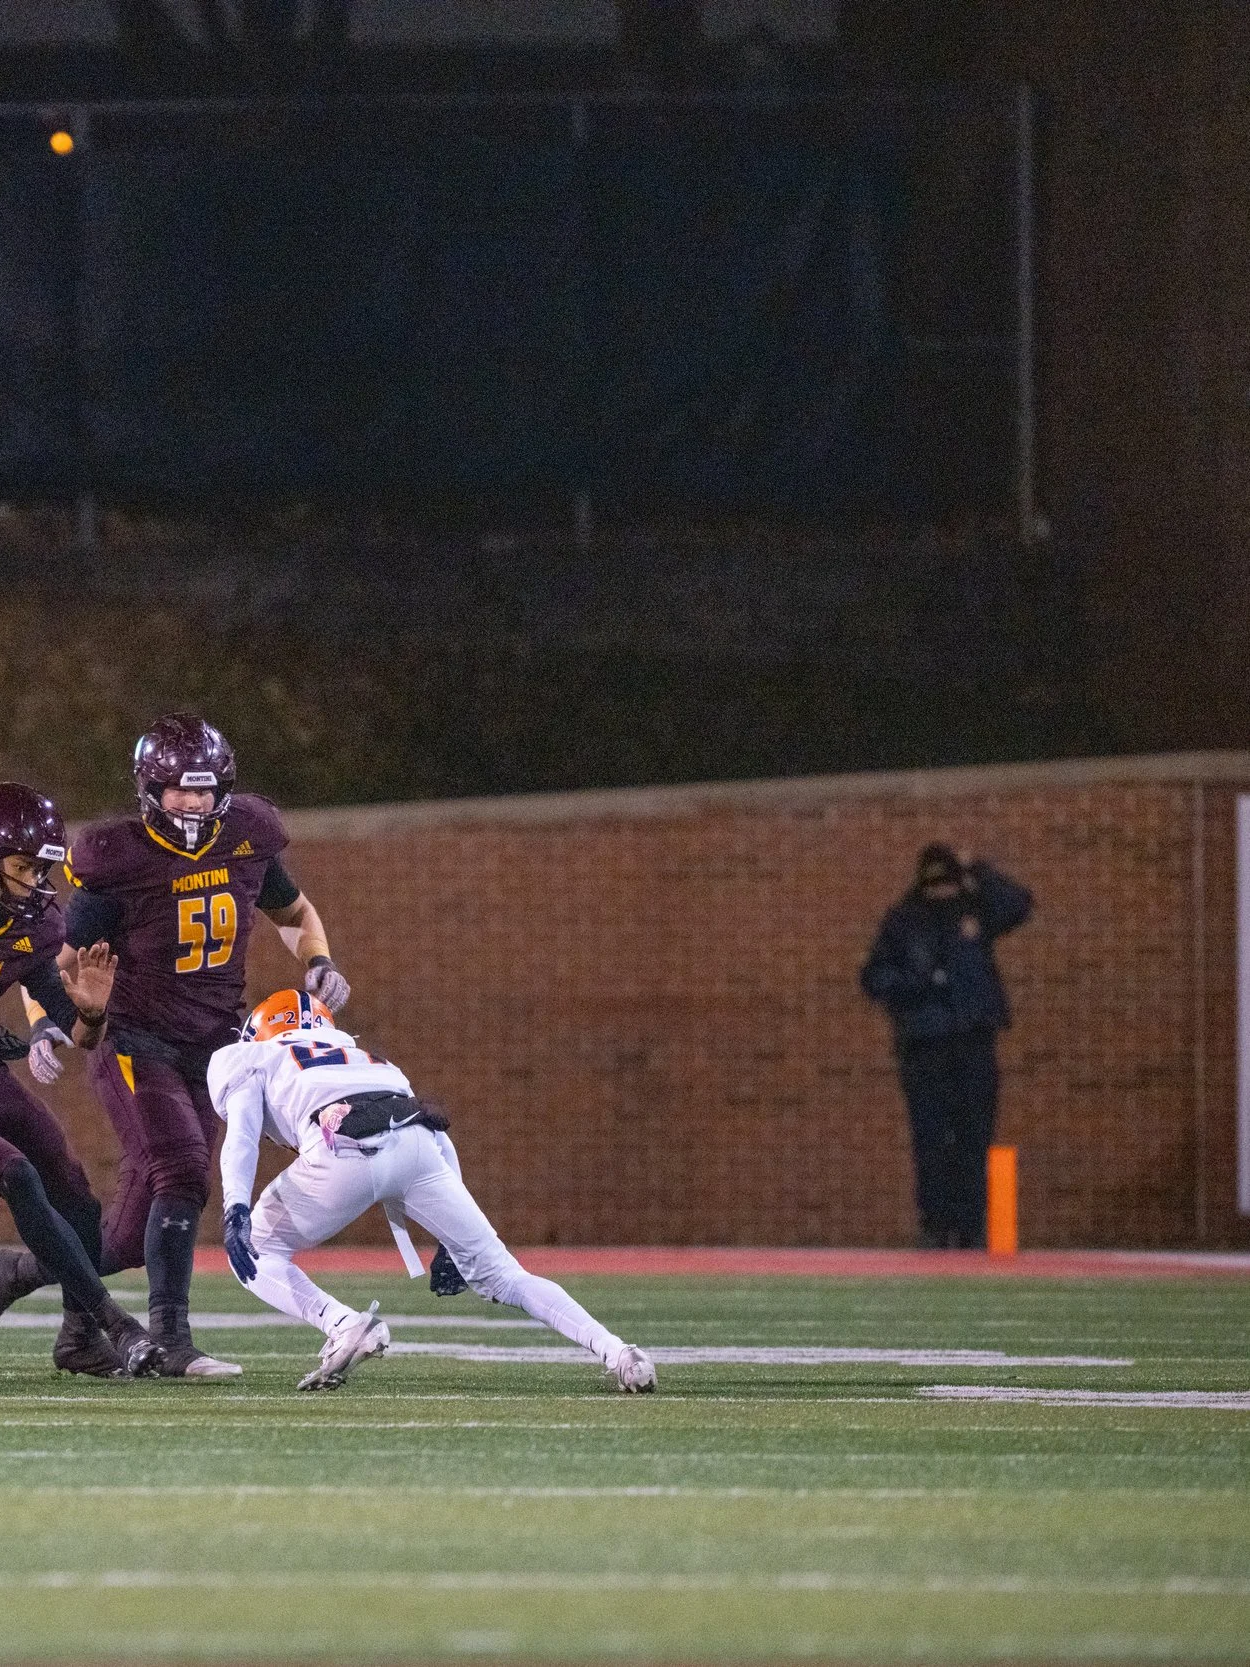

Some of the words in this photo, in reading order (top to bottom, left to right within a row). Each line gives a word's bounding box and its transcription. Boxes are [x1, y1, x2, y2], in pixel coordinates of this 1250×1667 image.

[187, 775, 212, 783] MONTINI
[172, 868, 229, 893] MONTINI
[175, 892, 237, 974] 59
[285, 1011, 296, 1025] 2
[314, 1014, 324, 1028] 4
